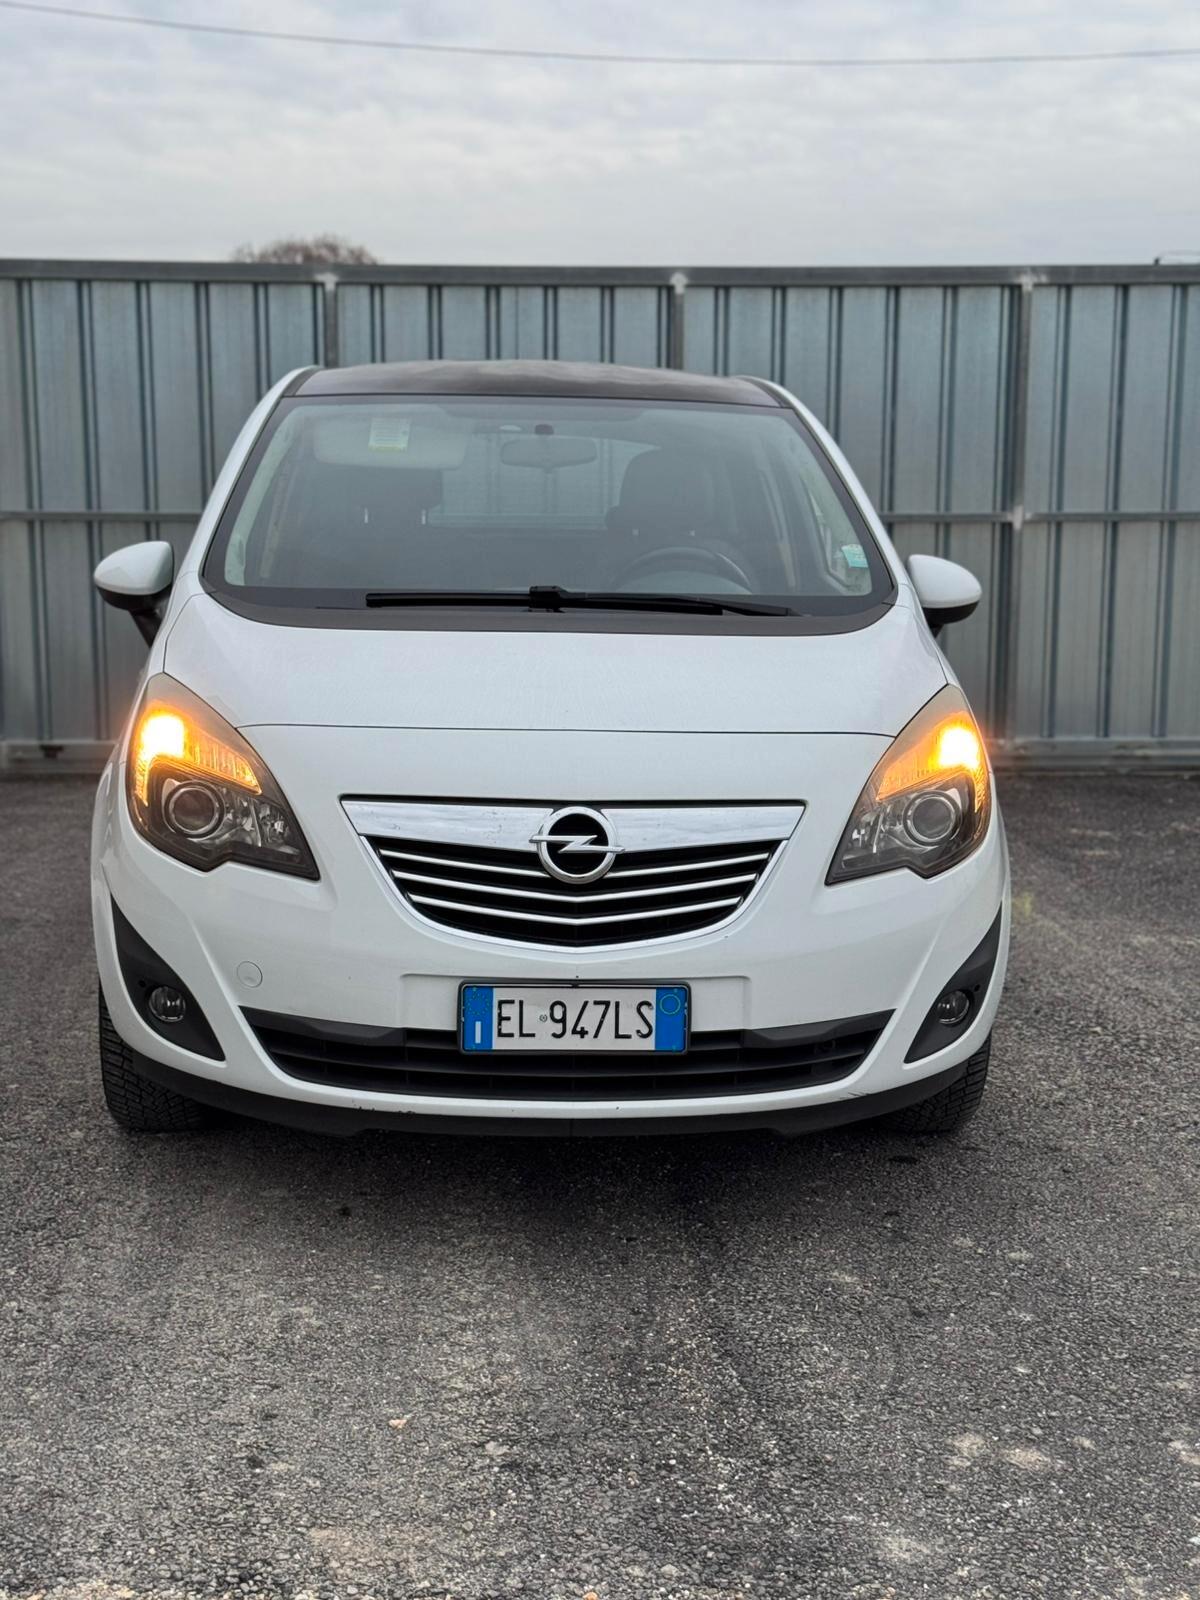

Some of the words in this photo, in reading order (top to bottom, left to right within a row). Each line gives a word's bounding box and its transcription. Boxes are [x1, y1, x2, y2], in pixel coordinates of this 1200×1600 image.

[475, 1021, 481, 1043] I
[497, 1000, 536, 1038] EL
[550, 1000, 654, 1039] 947LS
